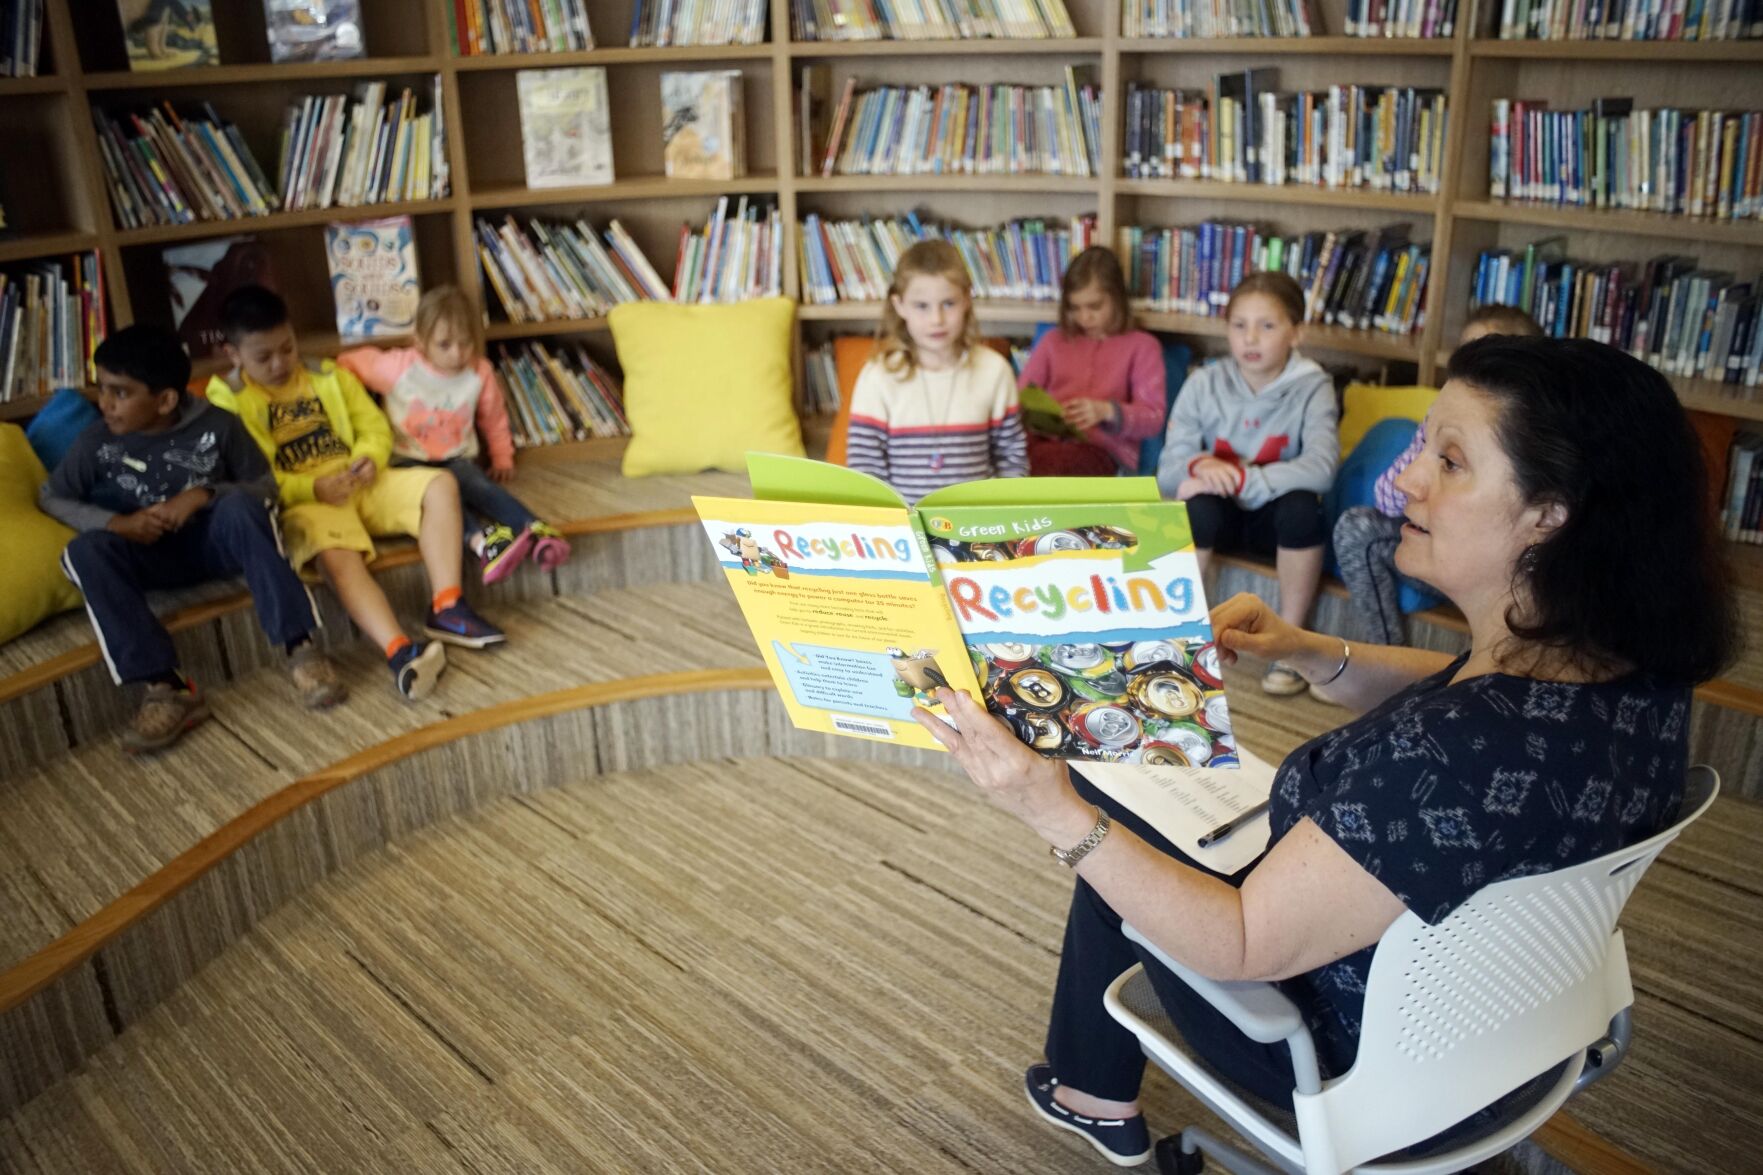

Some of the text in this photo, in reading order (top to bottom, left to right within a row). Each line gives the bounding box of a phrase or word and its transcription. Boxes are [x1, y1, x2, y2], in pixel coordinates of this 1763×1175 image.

[959, 522, 1006, 538] Green
[1011, 516, 1052, 535] Kids
[773, 529, 911, 563] Recycling
[802, 586, 831, 594] recycling
[948, 573, 1195, 622] Recycling
